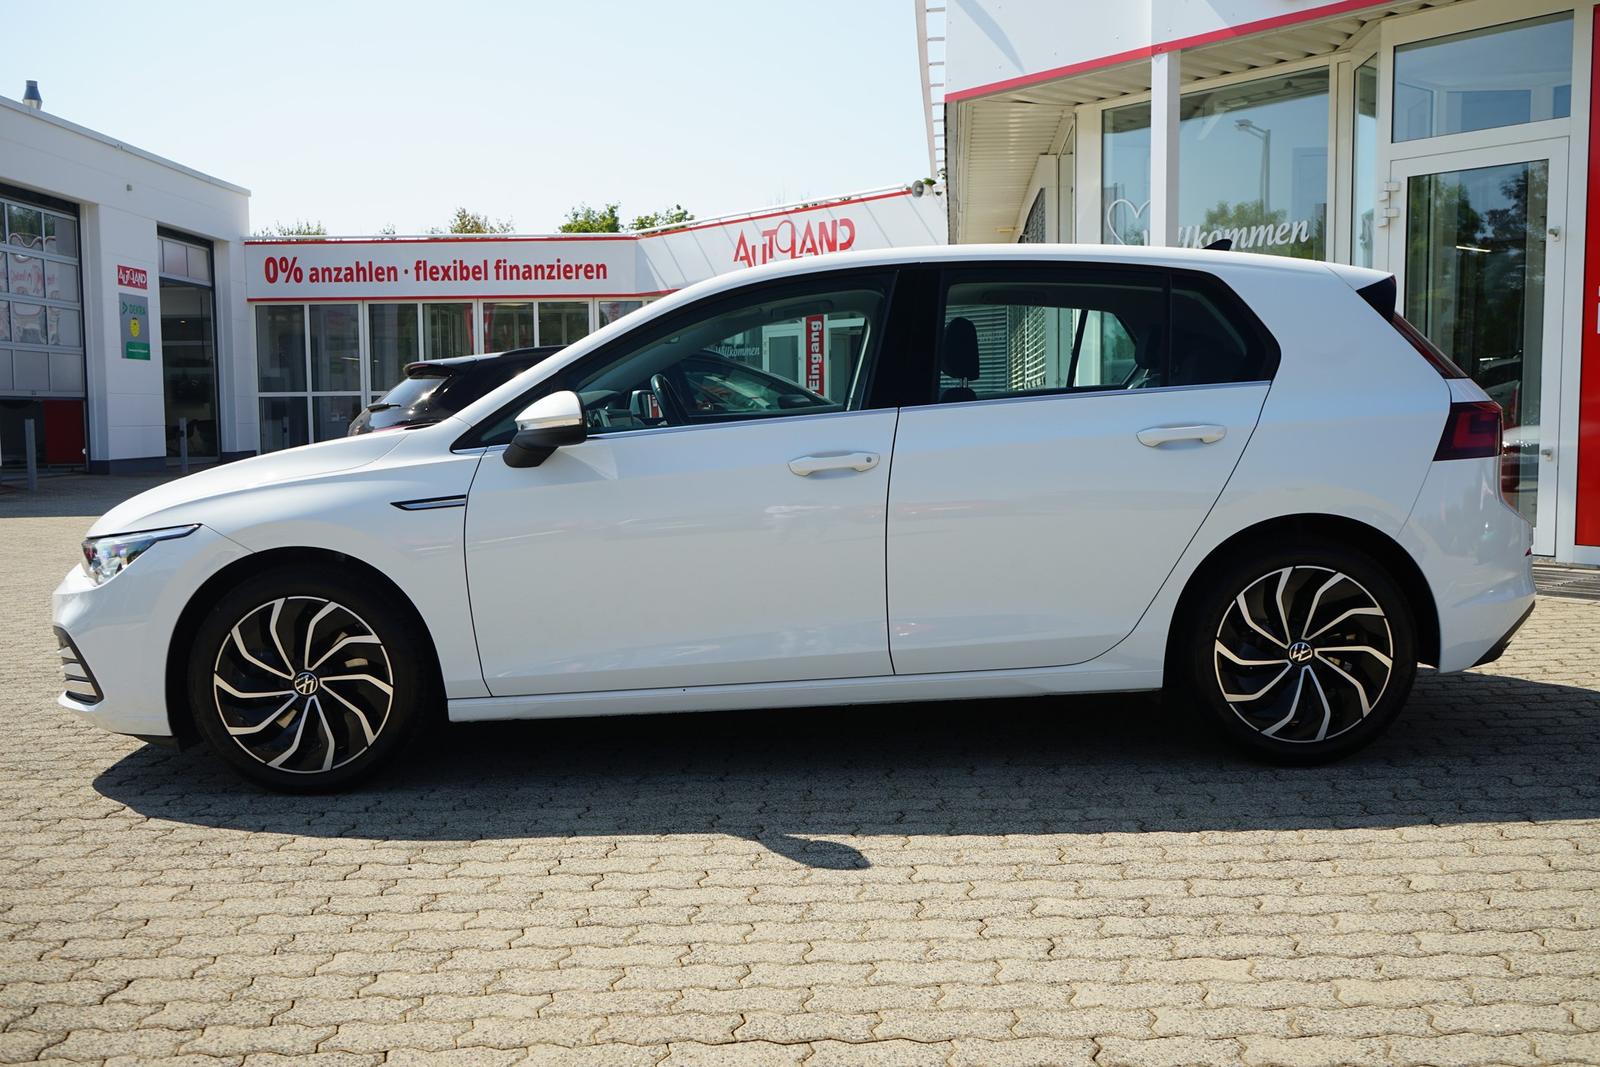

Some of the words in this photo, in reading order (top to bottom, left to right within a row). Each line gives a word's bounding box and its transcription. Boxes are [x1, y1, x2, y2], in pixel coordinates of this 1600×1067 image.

[264, 256, 303, 284] 0%
[309, 260, 398, 283] anzahlen
[415, 259, 489, 282] flexibel
[494, 258, 608, 281] finanzieren
[808, 320, 823, 391] Eingang
